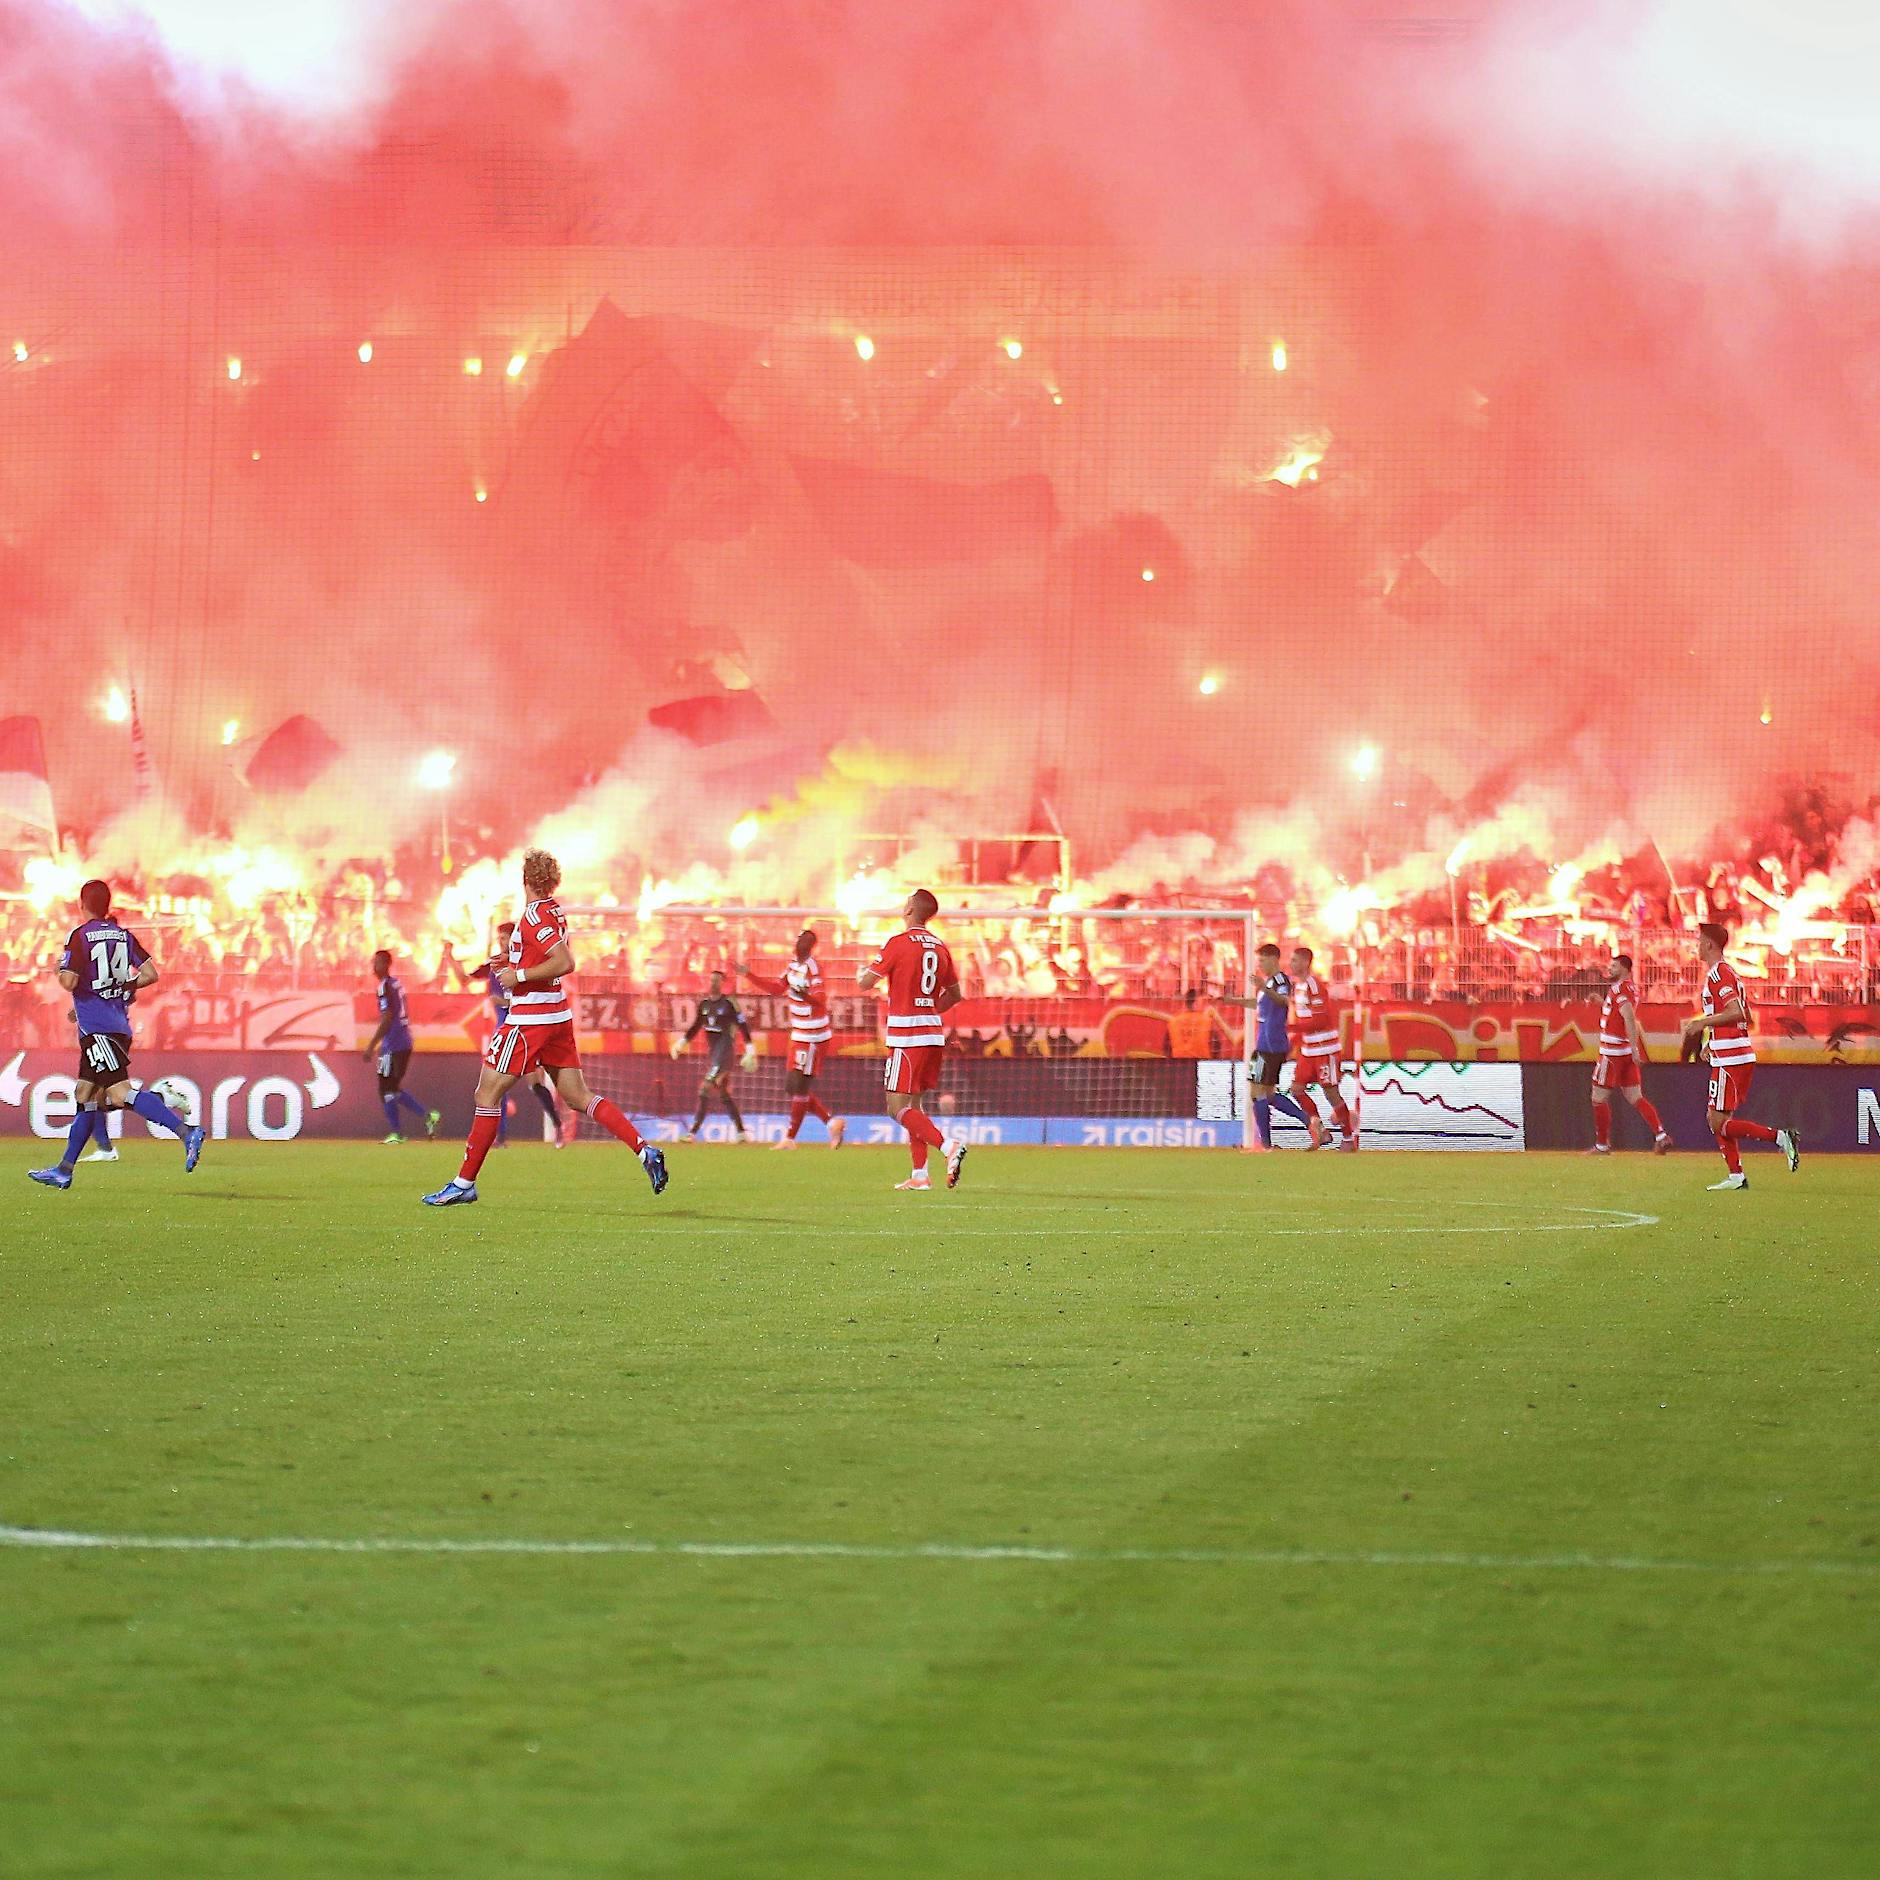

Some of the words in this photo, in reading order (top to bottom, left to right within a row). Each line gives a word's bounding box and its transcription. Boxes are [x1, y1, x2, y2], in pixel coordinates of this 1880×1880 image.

[90, 942, 130, 990] 14
[920, 951, 938, 995] 8
[86, 1042, 105, 1068] 14
[1114, 1120, 1217, 1148] raisin
